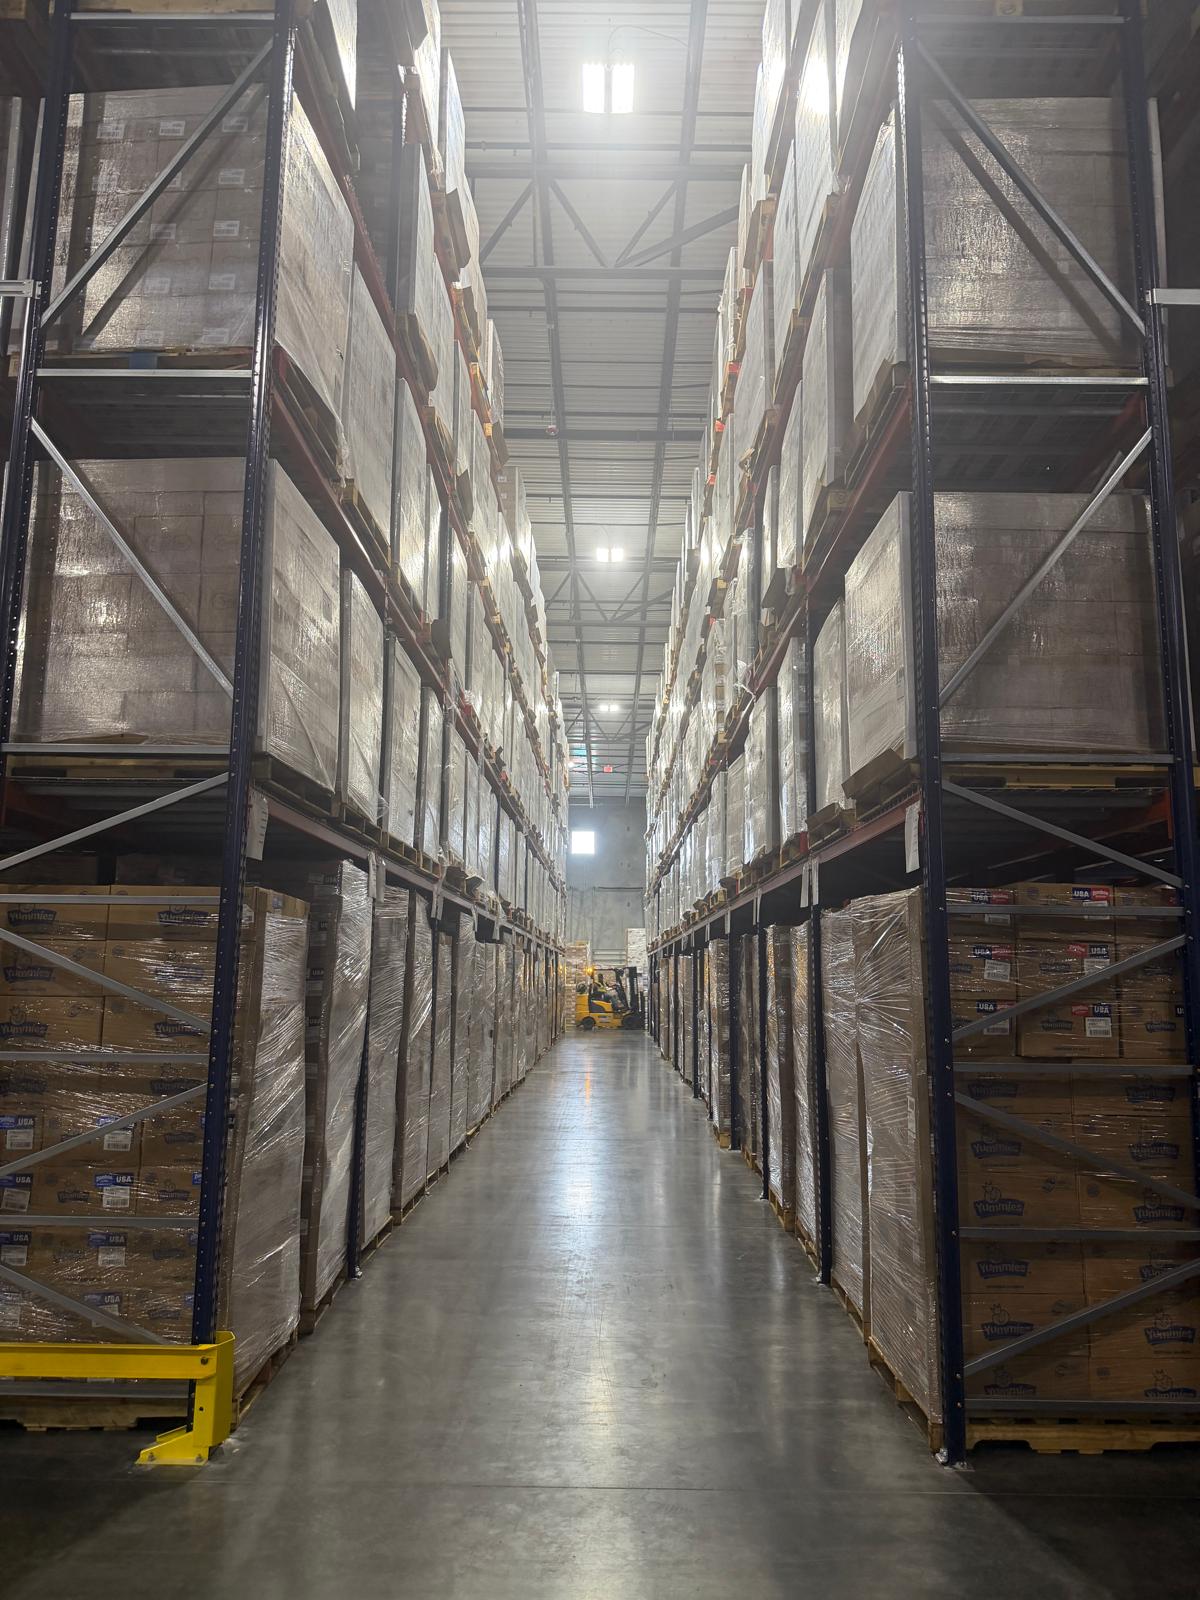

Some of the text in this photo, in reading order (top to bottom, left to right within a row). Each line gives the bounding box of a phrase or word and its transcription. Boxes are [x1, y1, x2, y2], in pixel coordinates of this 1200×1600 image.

[1074, 890, 1089, 898] USA
[979, 1003, 994, 1011] USA
[1094, 1005, 1109, 1013] USA
[18, 1118, 34, 1126] USA
[15, 1175, 32, 1183] USA
[116, 1175, 132, 1183] USA
[13, 1233, 29, 1241] USA
[109, 1235, 125, 1243] USA
[104, 1295, 120, 1304] USA
